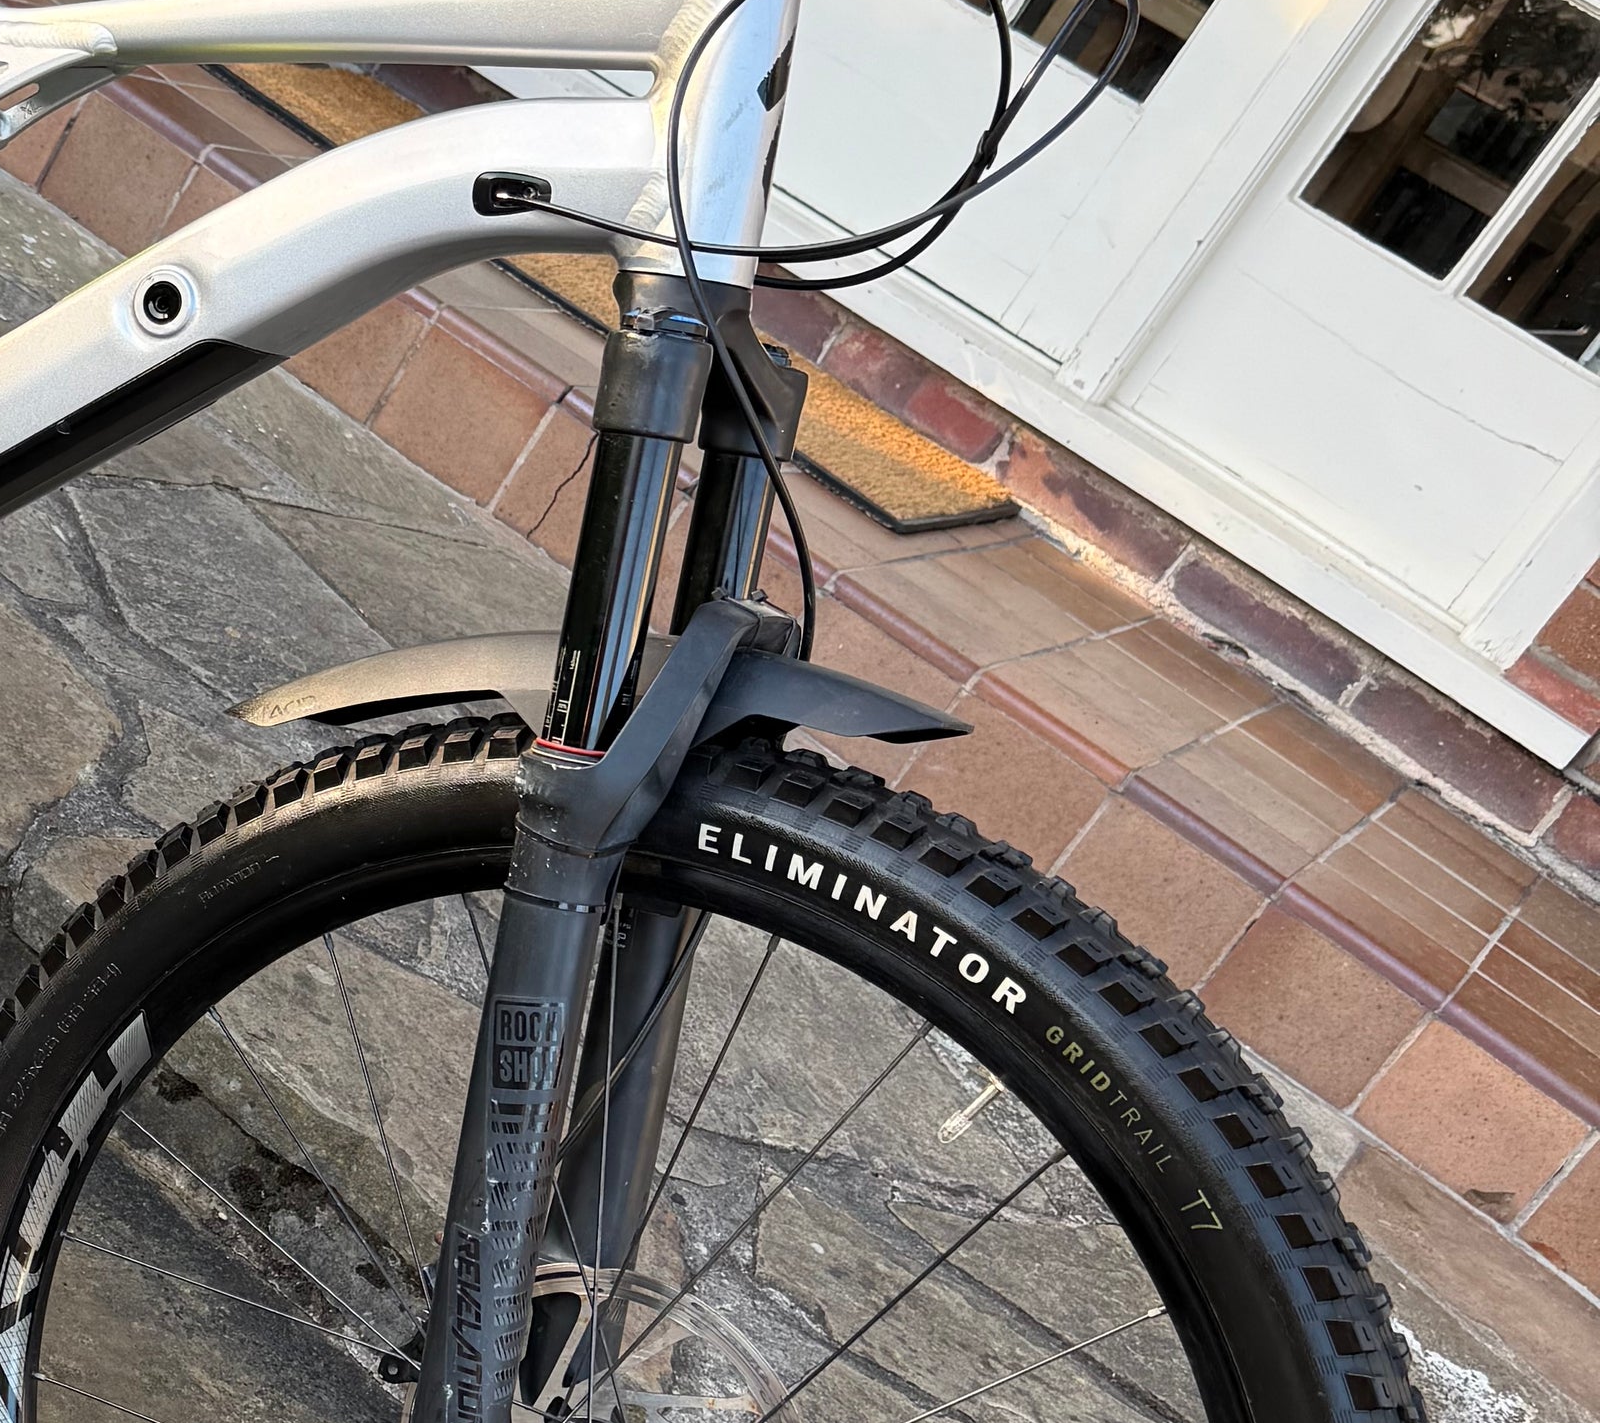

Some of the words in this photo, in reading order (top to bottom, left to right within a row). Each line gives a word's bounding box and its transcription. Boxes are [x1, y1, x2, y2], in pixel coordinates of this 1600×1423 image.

[500, 1009, 558, 1043] ROCK
[698, 823, 1028, 1016] ELIMINATOR
[1178, 1188, 1224, 1234] T7
[499, 1049, 557, 1083] SHOX
